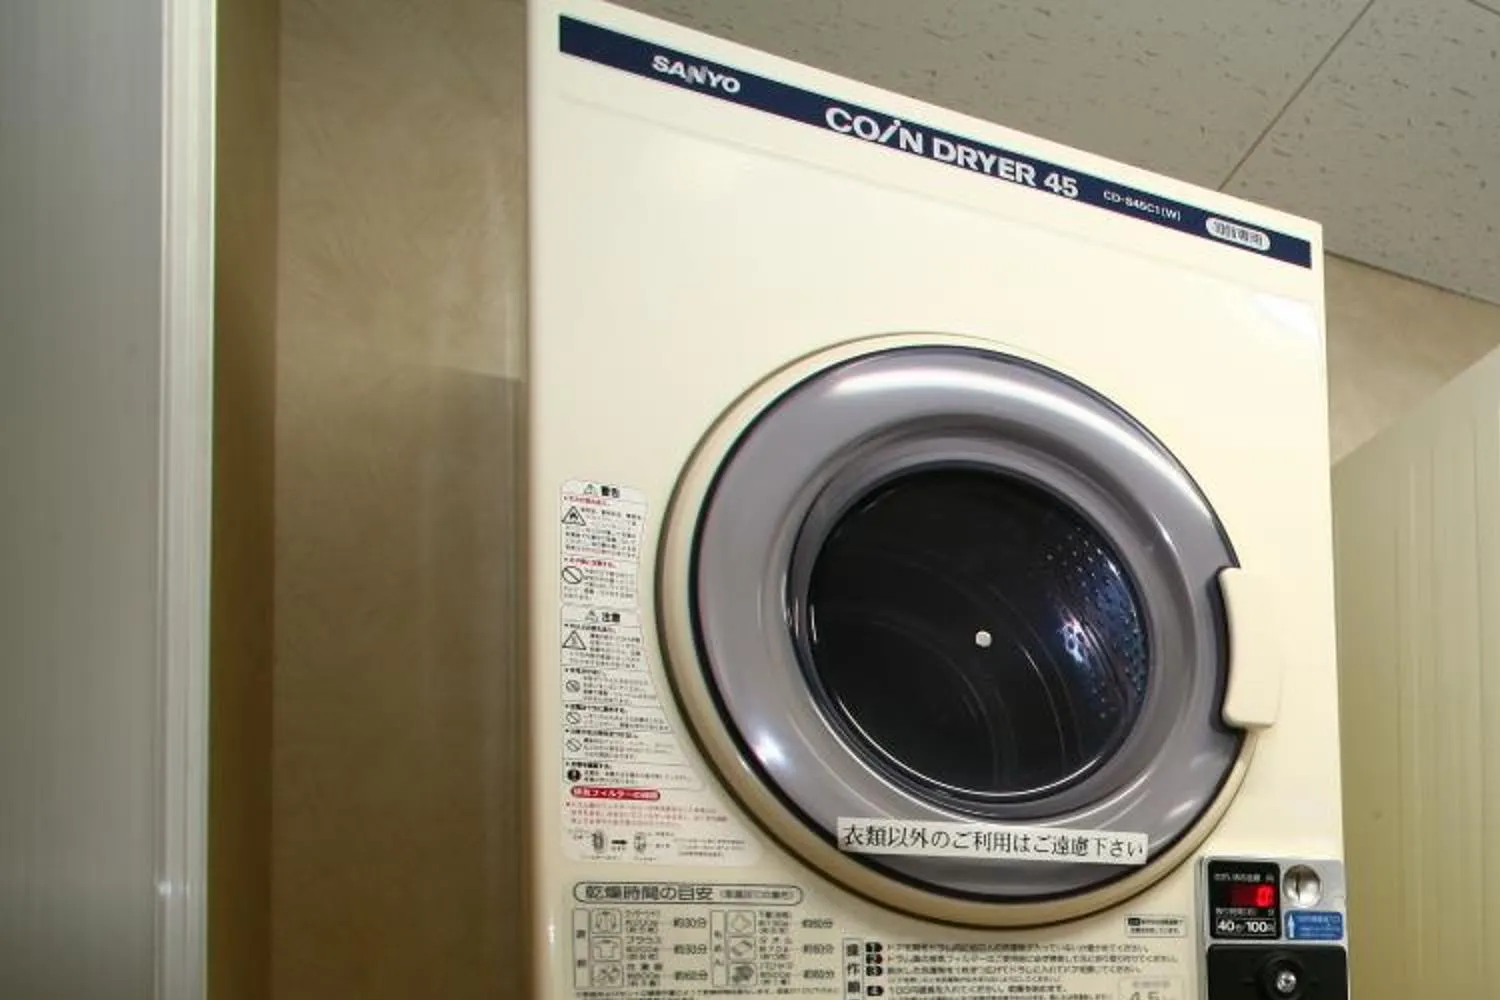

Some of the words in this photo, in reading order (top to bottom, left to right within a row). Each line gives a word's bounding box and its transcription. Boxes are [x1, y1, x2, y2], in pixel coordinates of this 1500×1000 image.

[652, 54, 741, 94] SANYO
[825, 106, 924, 155] COIN
[932, 136, 1037, 187] DRYER
[1044, 172, 1079, 199] 45
[842, 824, 1145, 858] 衣類以外のご利用はご遠慮下さい
